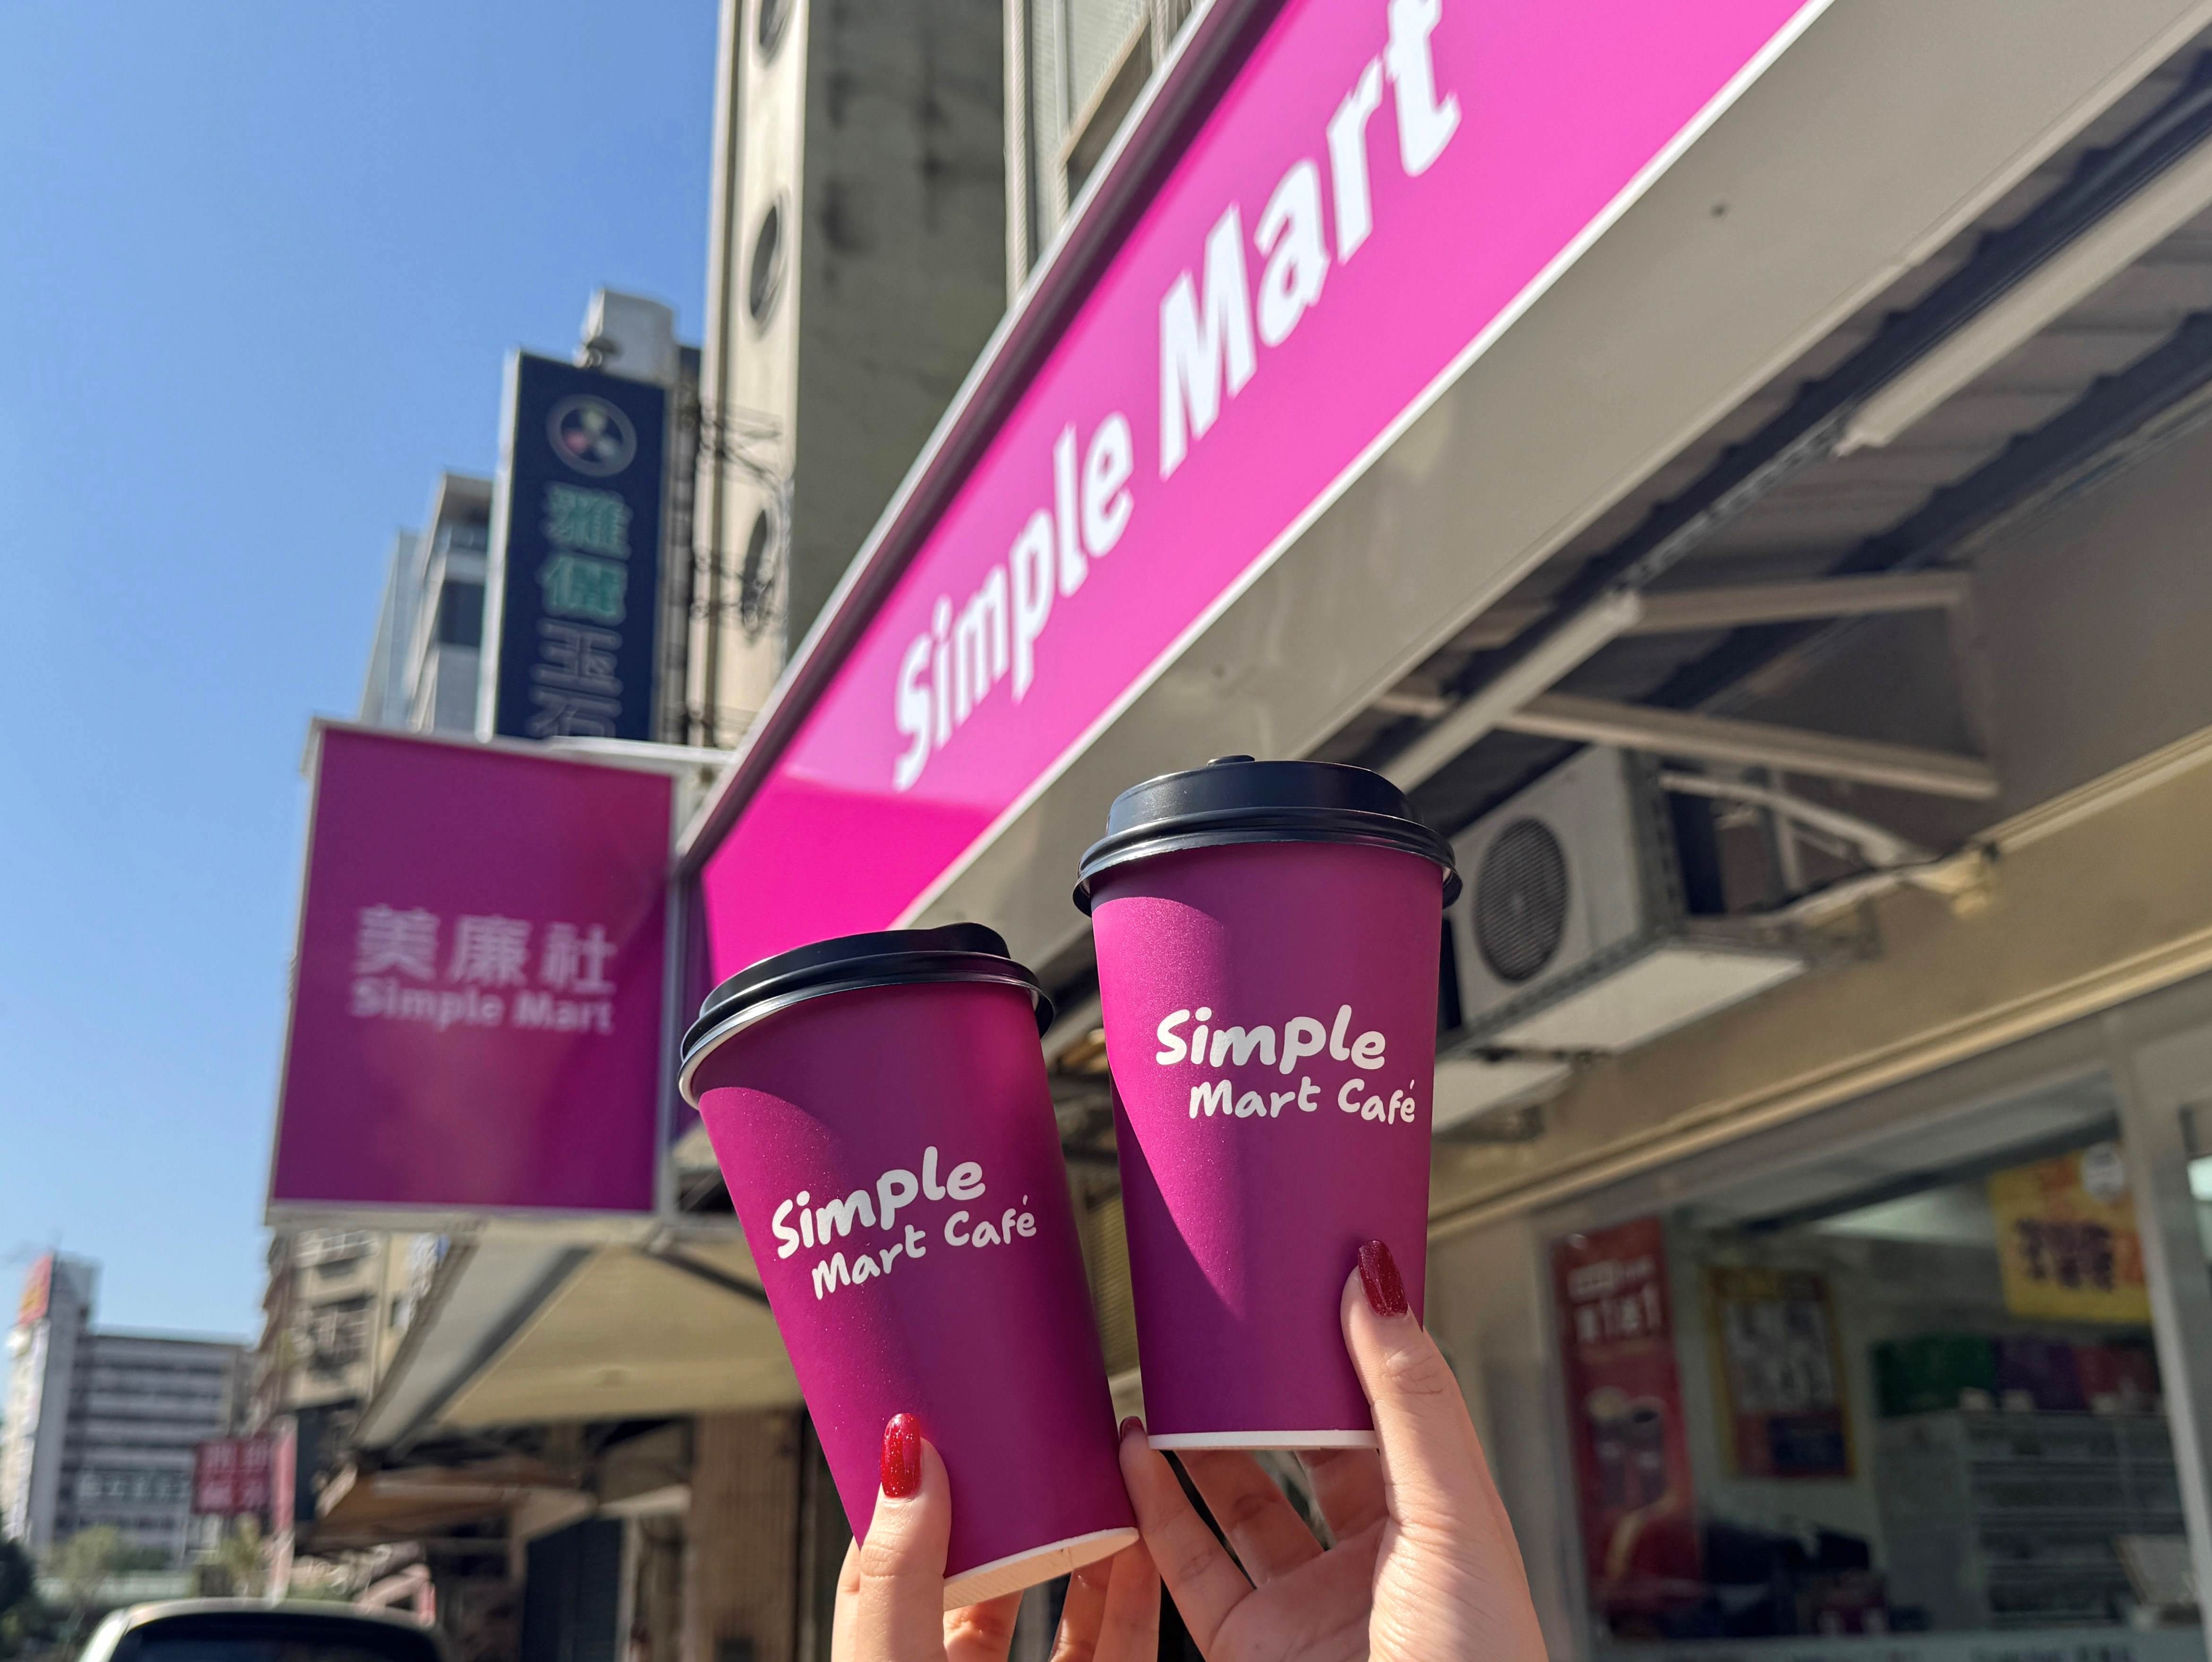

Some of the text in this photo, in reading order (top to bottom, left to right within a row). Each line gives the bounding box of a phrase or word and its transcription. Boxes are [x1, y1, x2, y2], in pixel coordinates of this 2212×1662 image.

[892, 0, 1461, 792] Simple Mart
[354, 904, 617, 995] 美廉社
[349, 977, 615, 1034] Simple Mart
[1156, 1004, 1385, 1074] Simple
[1189, 1076, 1416, 1125] Mart Café
[772, 1146, 985, 1259] Simple
[812, 1195, 1037, 1300] Mart Café
